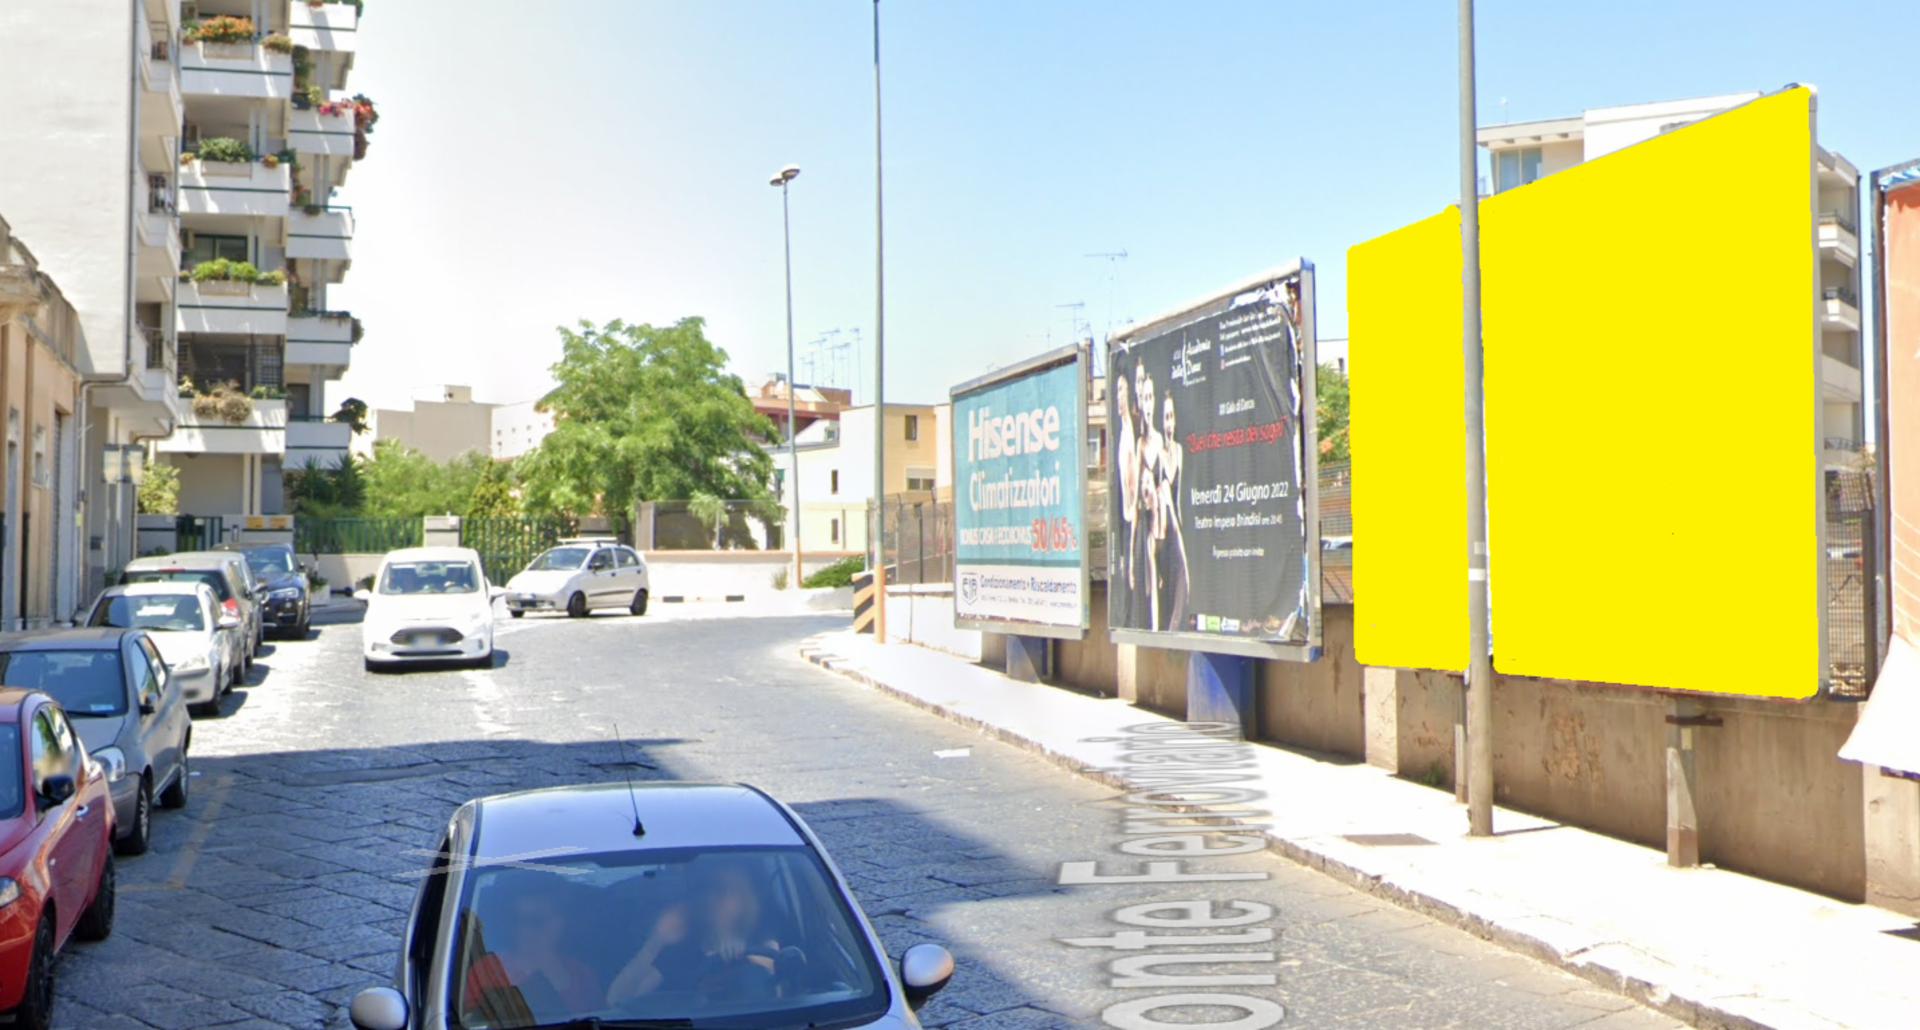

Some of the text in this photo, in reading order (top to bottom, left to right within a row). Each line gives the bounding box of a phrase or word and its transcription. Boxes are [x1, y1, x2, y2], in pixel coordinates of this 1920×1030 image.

[968, 405, 1060, 463] Hisense
[969, 460, 1060, 511] Climatizzatori
[1223, 484, 1235, 504] 24
[1236, 481, 1271, 506] Giugno
[1271, 481, 1289, 499] 2022
[1236, 511, 1261, 528] Brindisi
